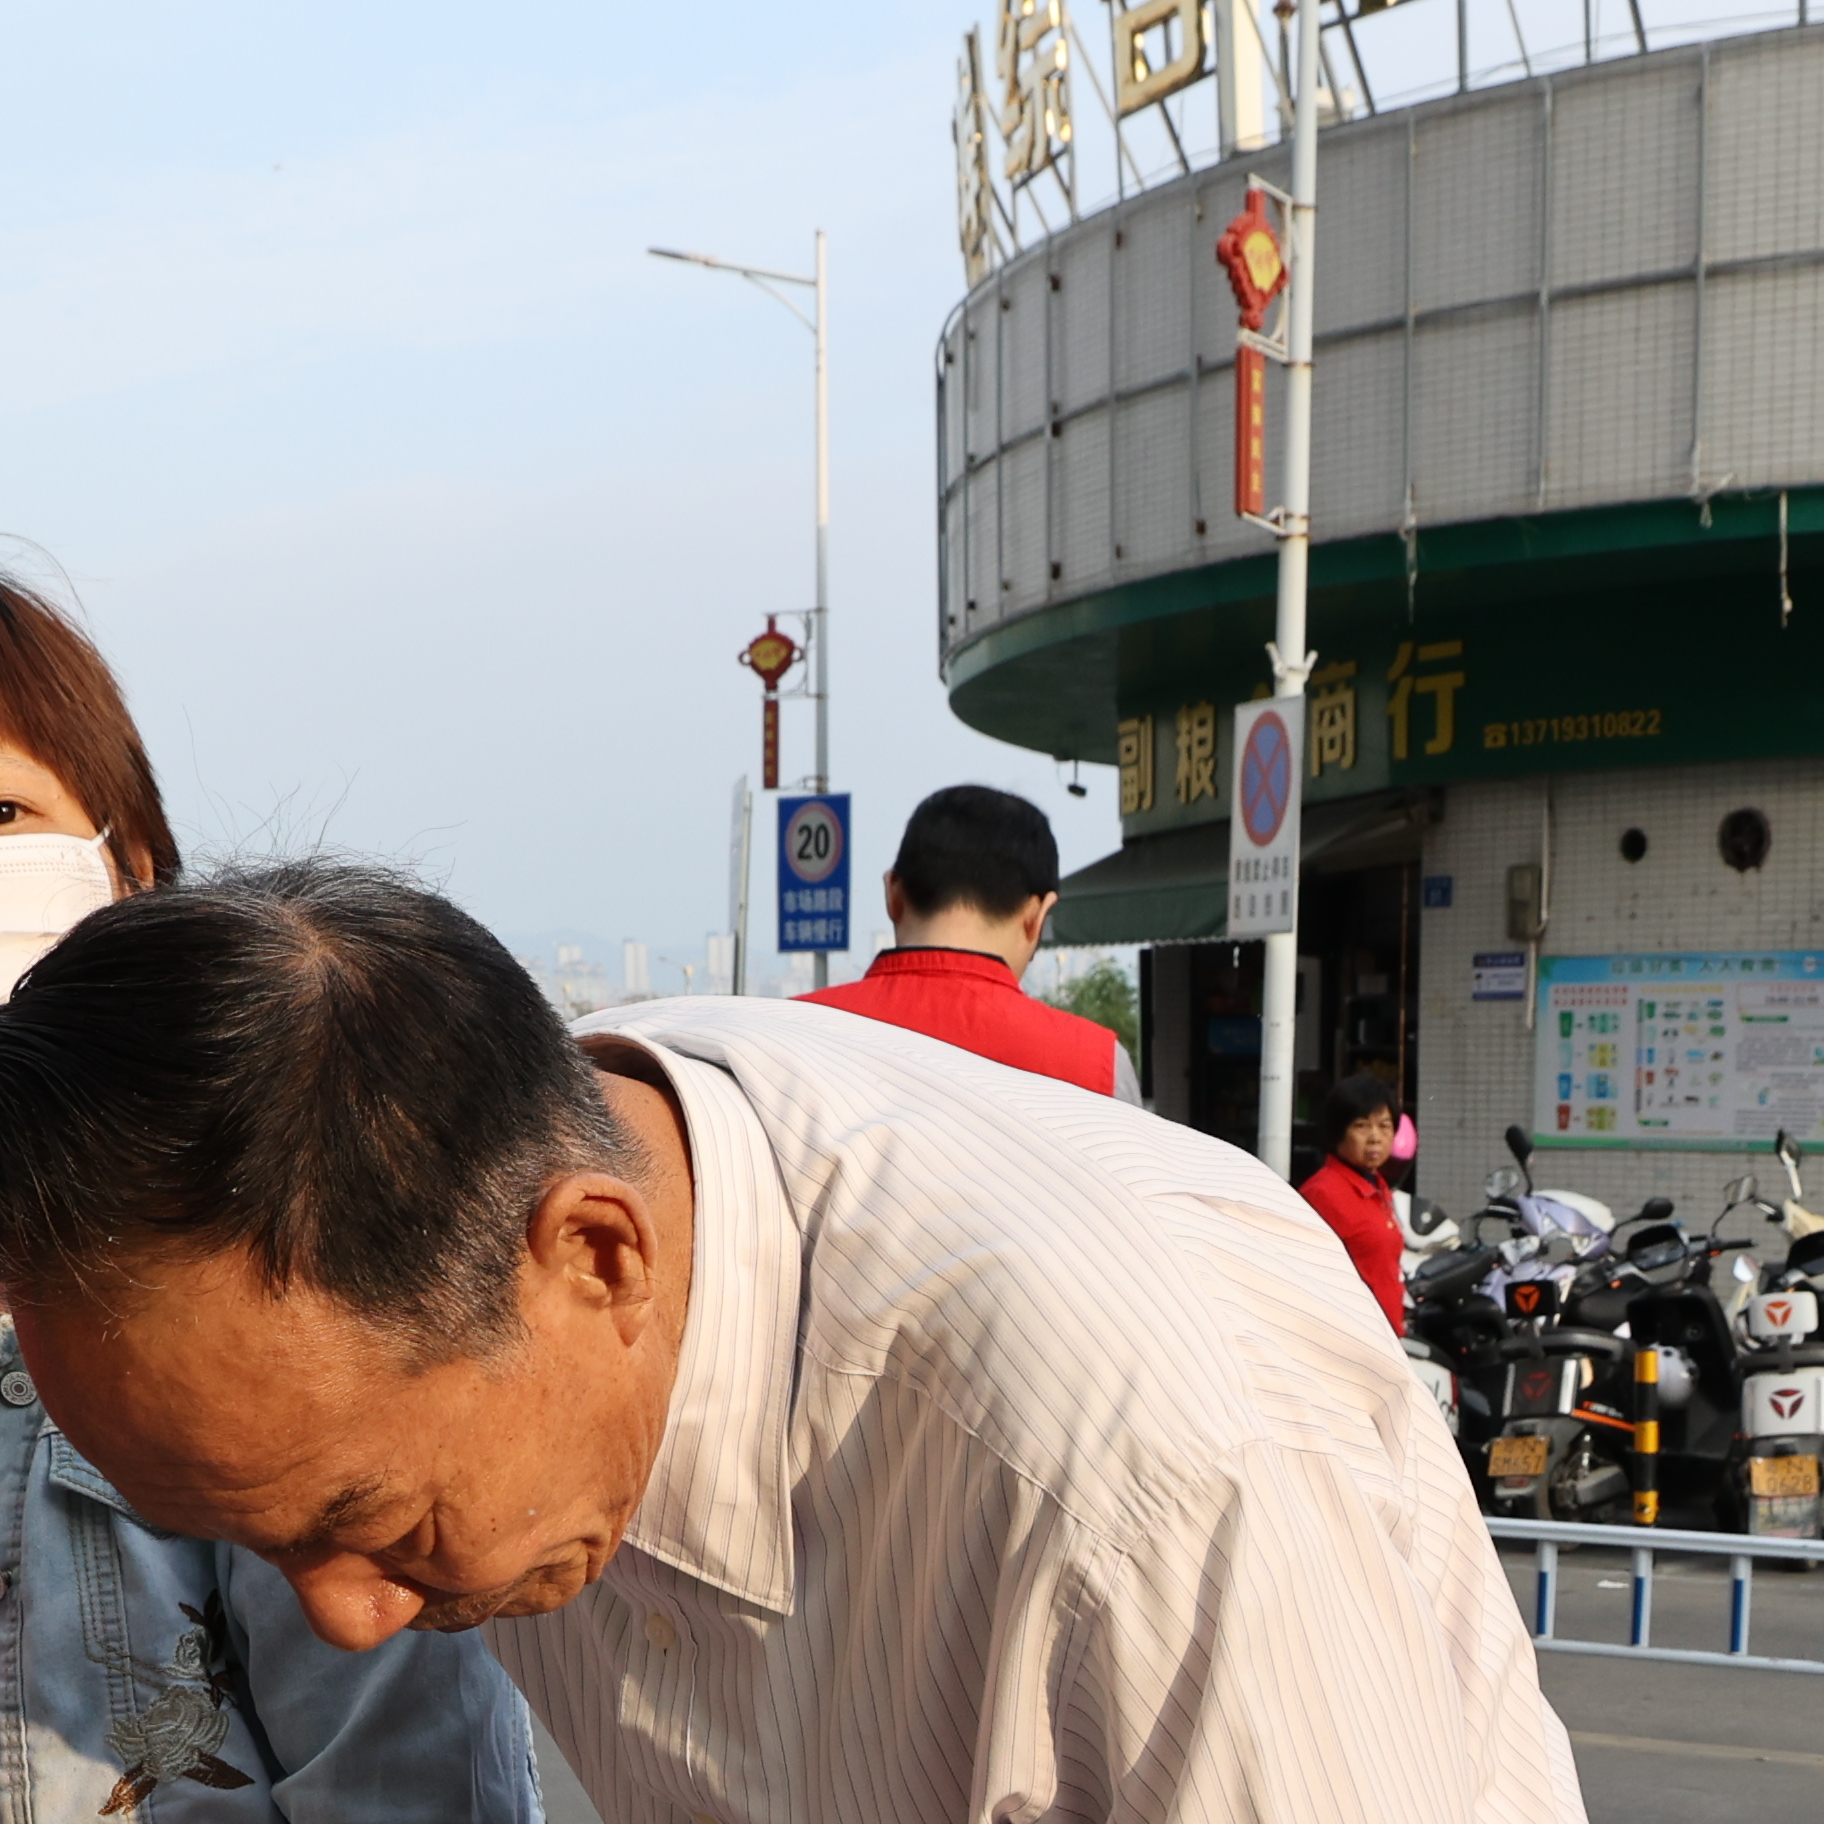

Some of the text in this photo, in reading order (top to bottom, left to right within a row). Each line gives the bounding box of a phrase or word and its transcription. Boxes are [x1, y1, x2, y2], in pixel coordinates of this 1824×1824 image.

[1117, 640, 1466, 814] 副粮商行
[797, 823, 830, 861] 20
